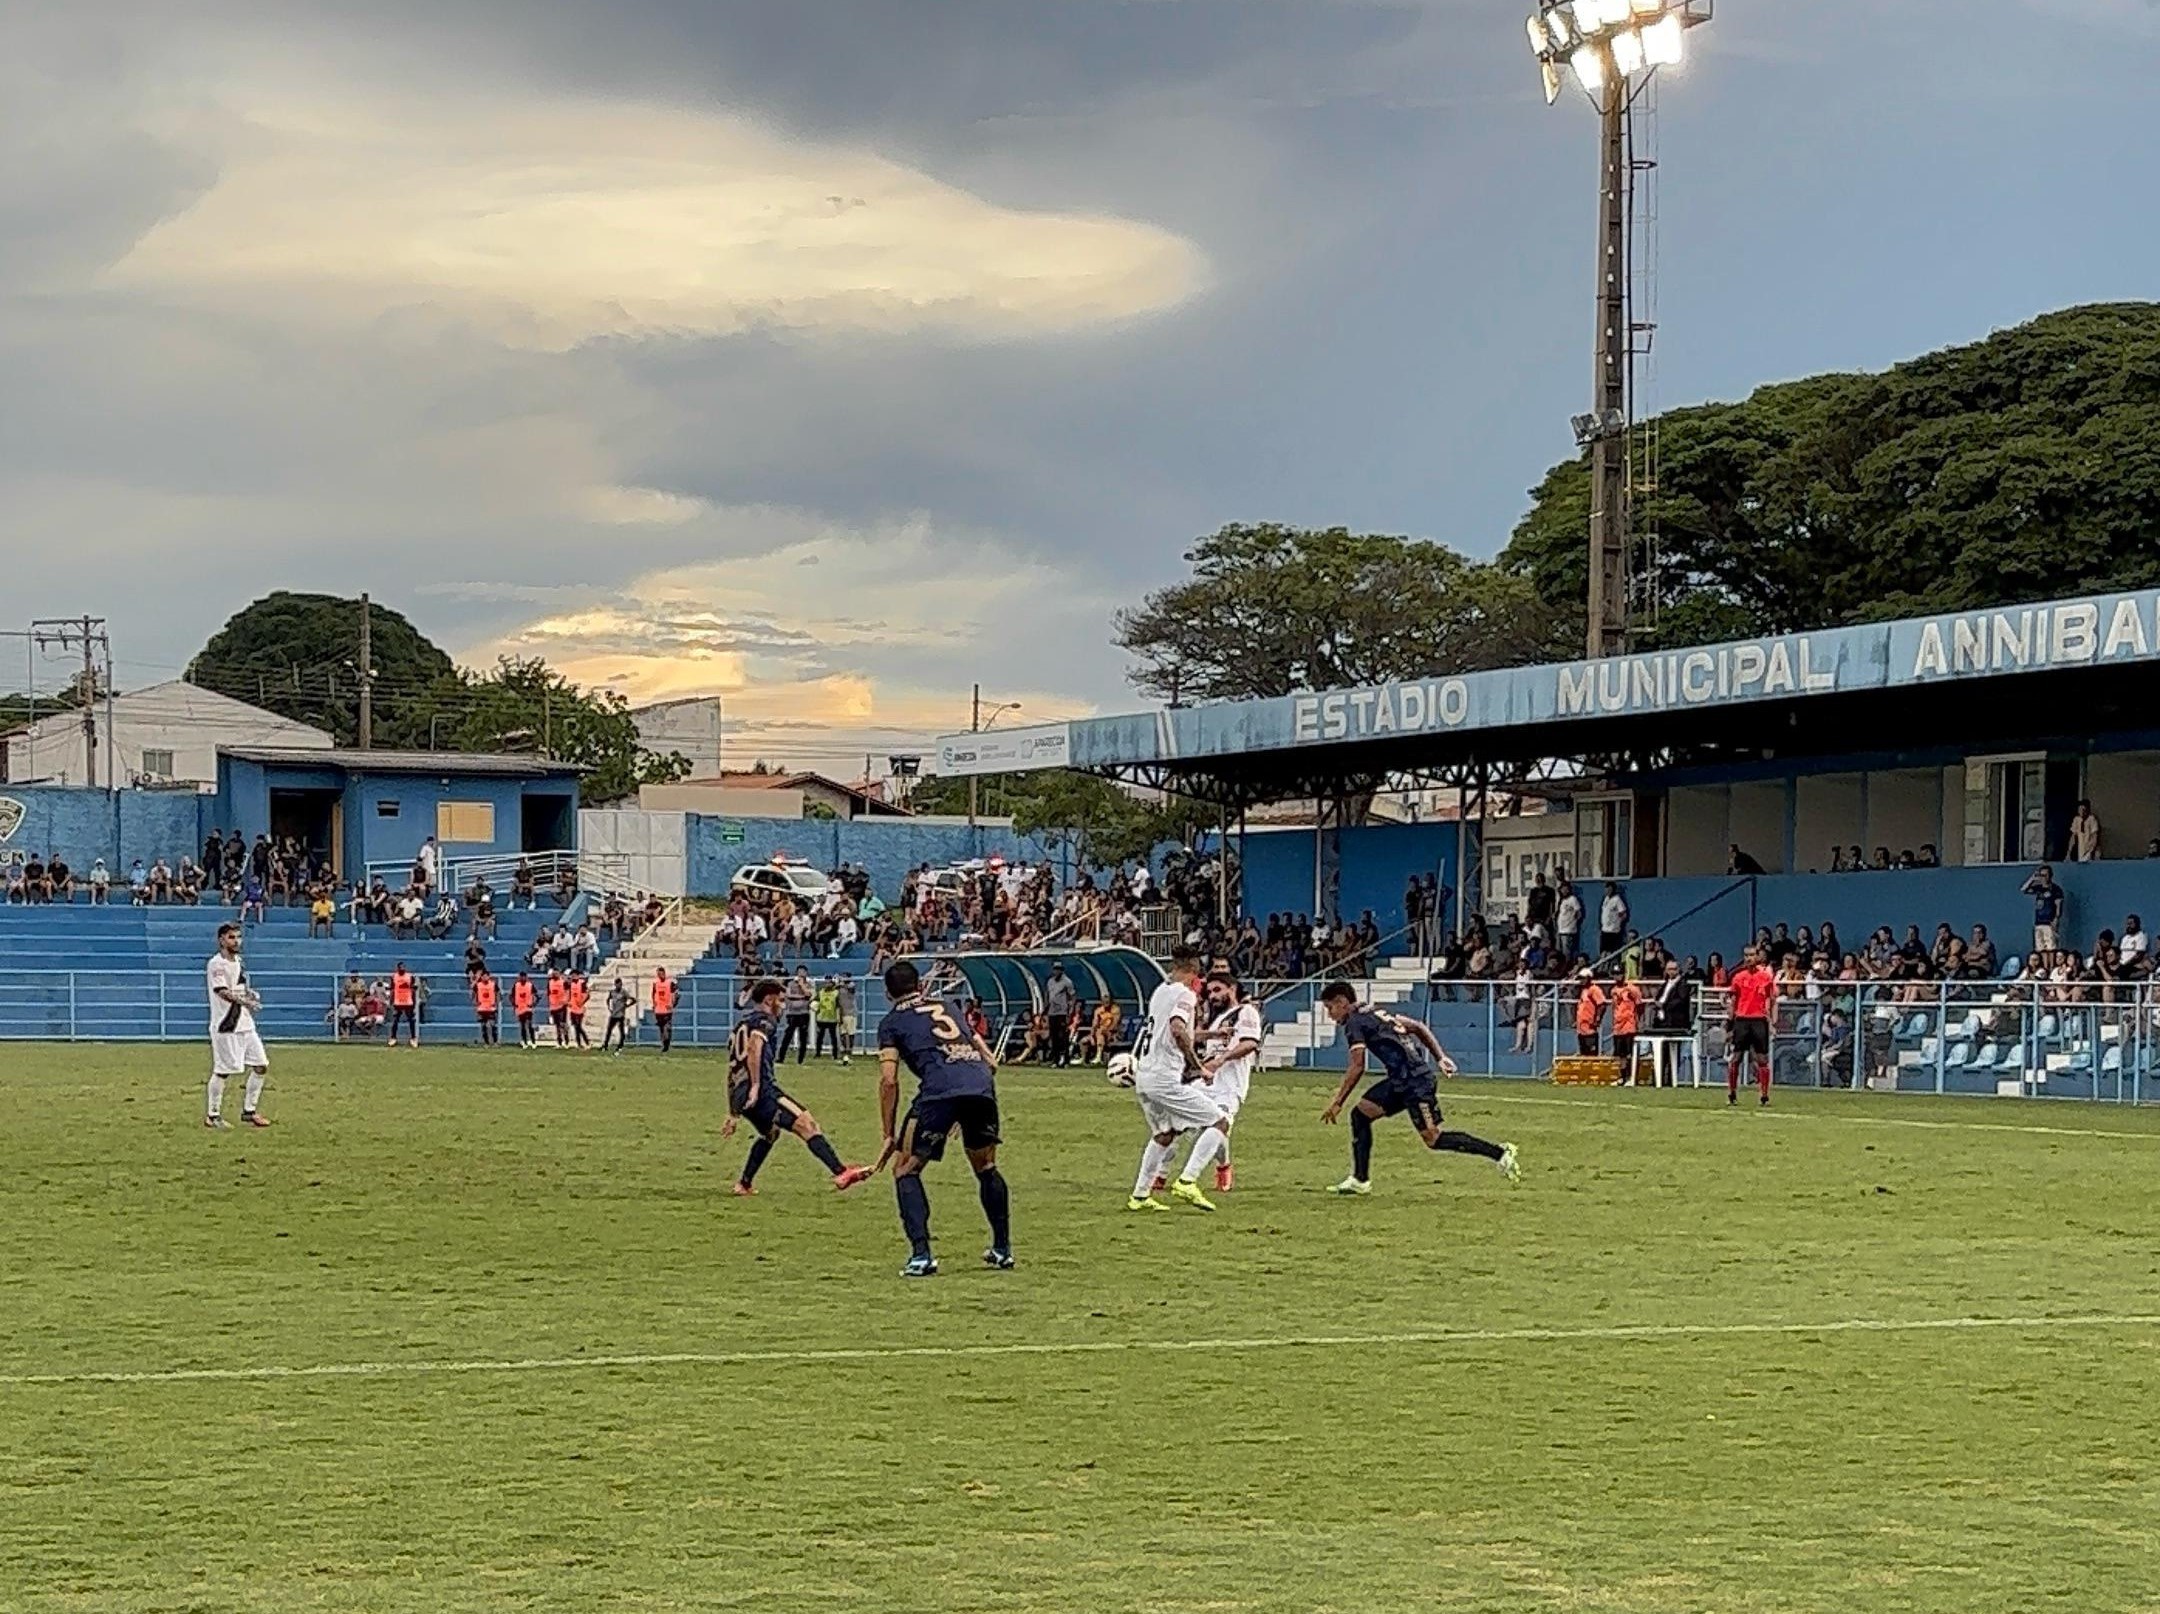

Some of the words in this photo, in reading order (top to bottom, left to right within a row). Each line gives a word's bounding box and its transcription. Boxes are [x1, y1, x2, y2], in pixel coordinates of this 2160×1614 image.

[1557, 637, 1835, 716] MUNICIPAL
[1913, 597, 2160, 677] ANNIBA
[914, 1004, 961, 1040] 3
